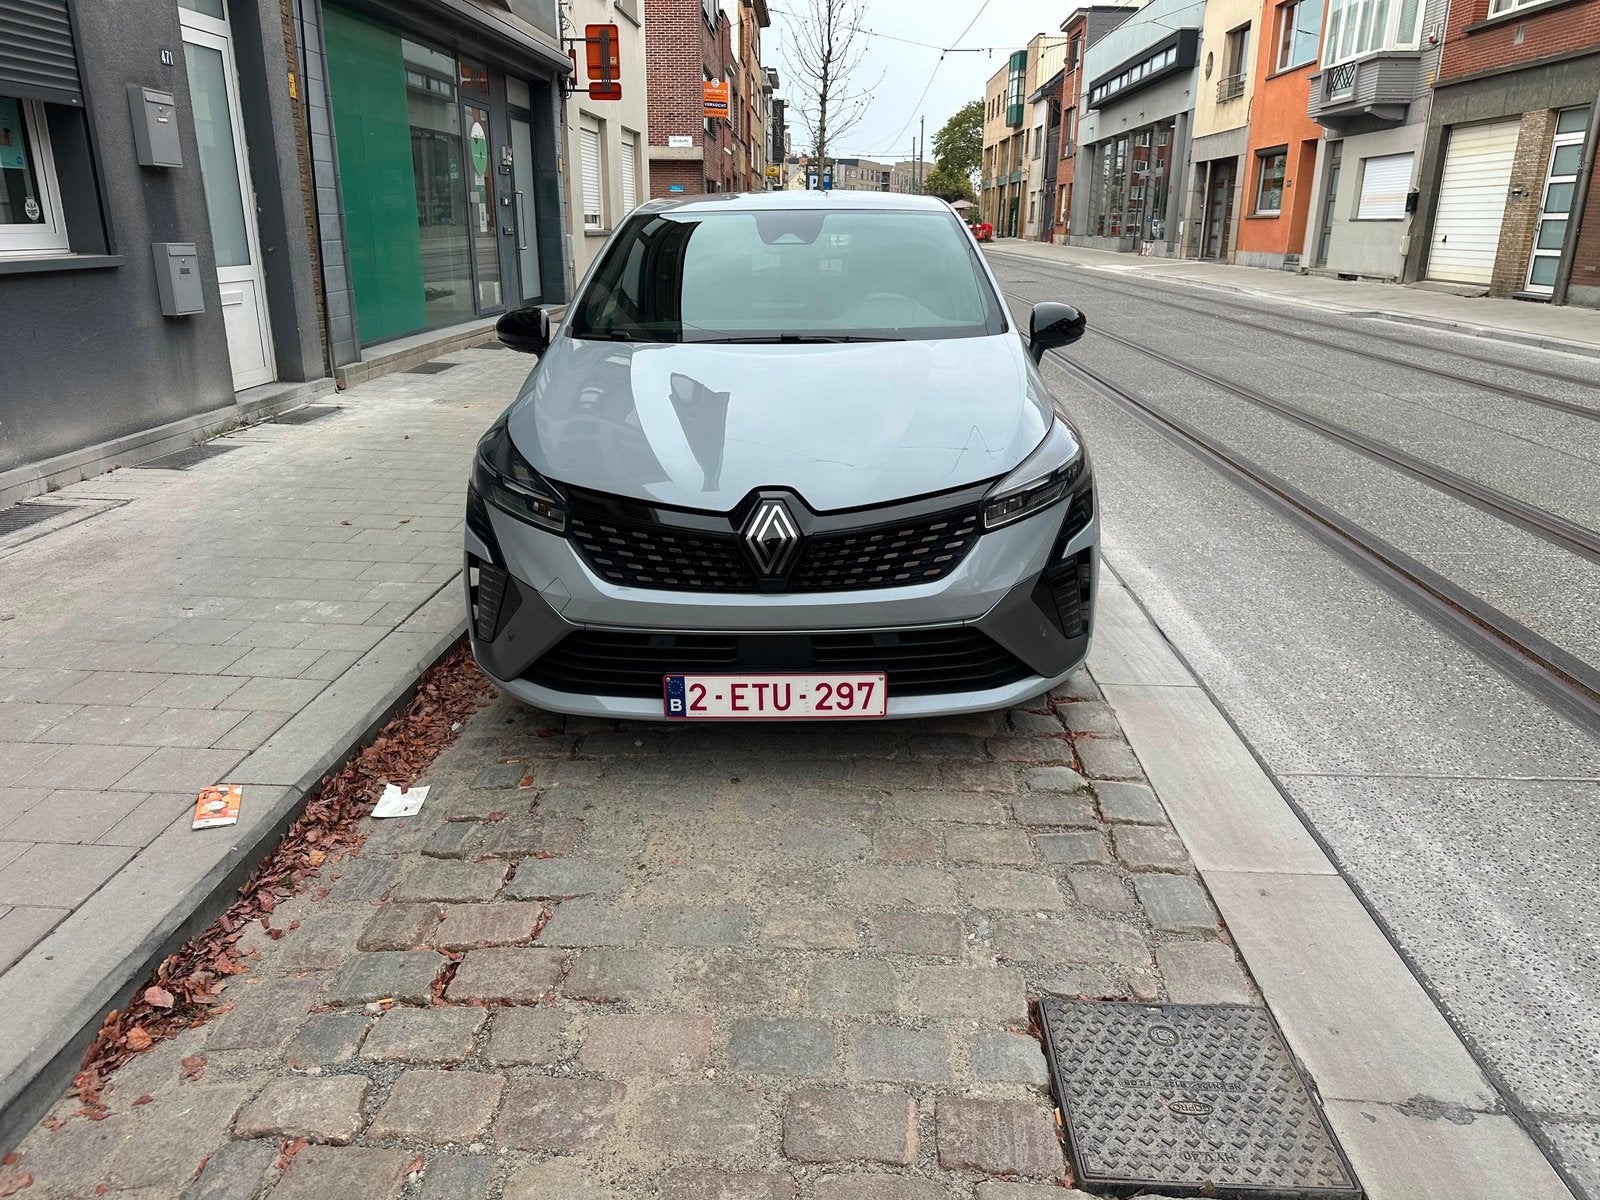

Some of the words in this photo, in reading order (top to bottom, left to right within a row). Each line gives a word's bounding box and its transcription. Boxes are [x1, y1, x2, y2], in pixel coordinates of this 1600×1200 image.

[161, 49, 174, 65] 471
[670, 698, 683, 712] B
[689, 682, 875, 712] 2-ETU-297
